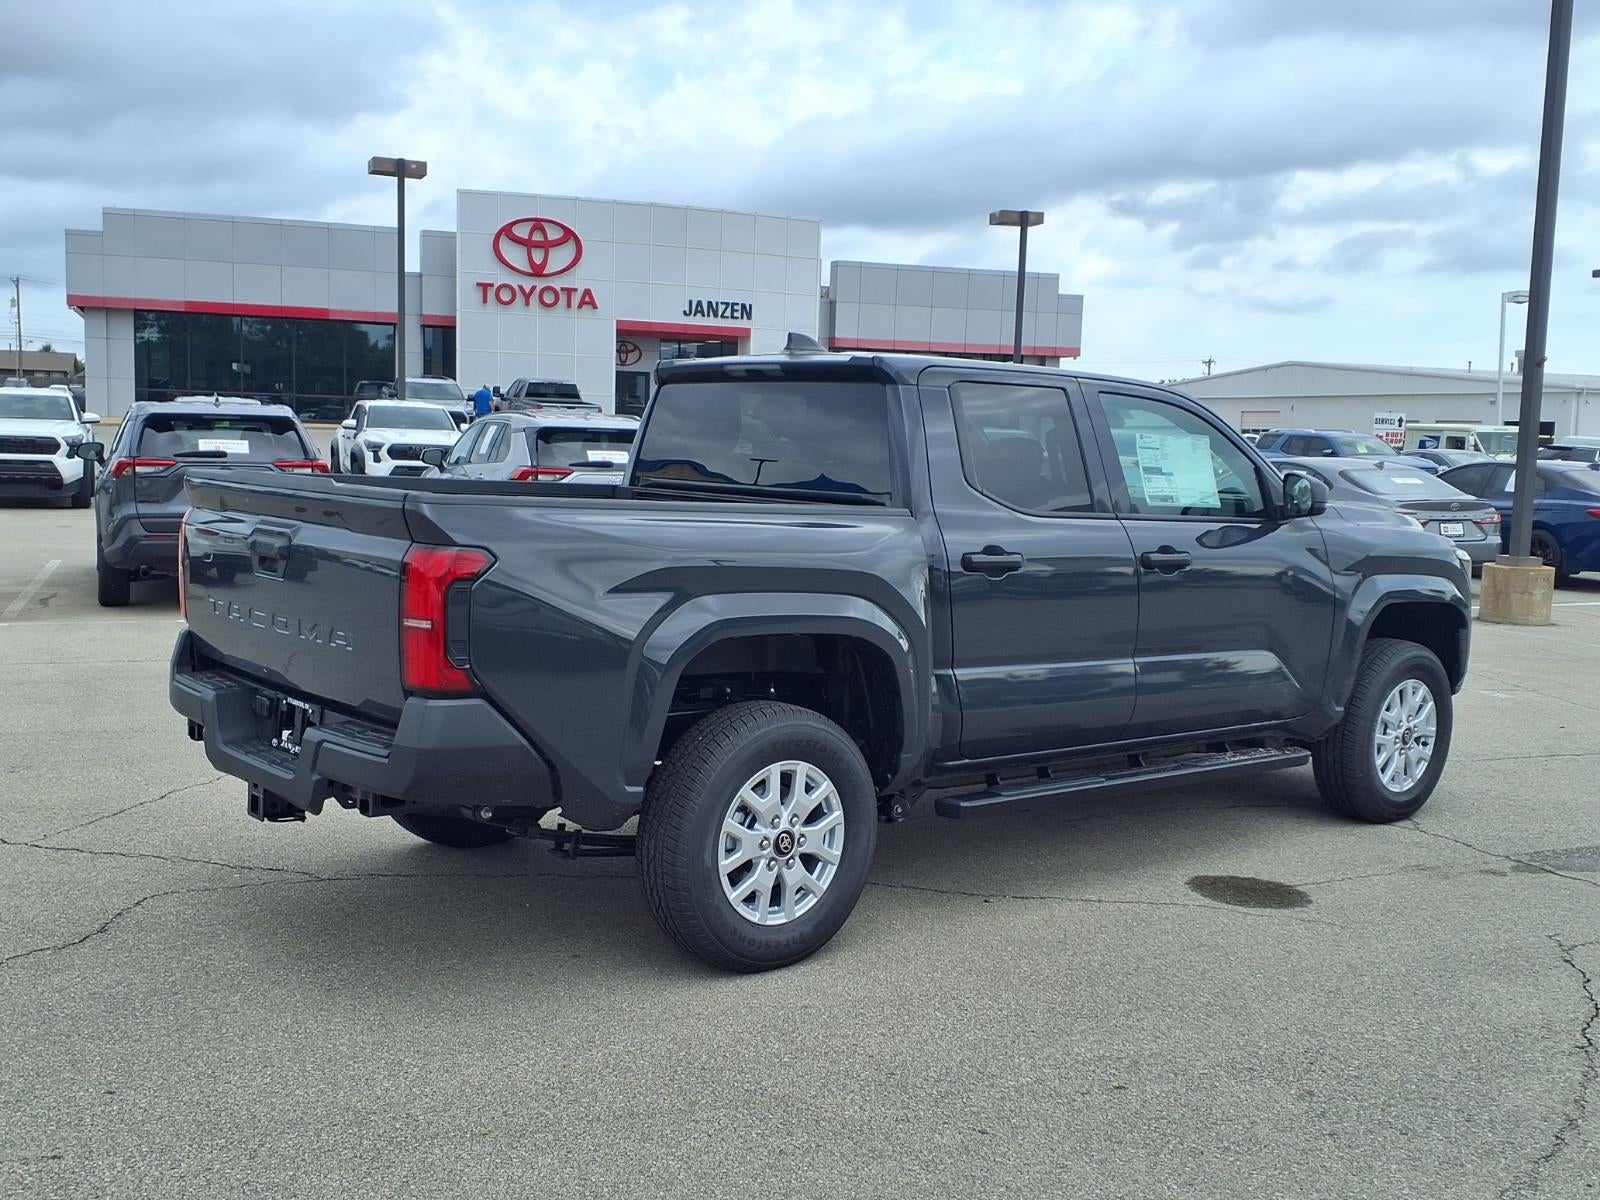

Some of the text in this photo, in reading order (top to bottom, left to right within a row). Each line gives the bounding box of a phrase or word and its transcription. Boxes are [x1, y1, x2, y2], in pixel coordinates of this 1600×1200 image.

[476, 281, 598, 310] TOYOTA
[682, 299, 753, 321] JANZEN
[1374, 417, 1396, 426] SERVICE
[208, 595, 354, 652] TACOMA
